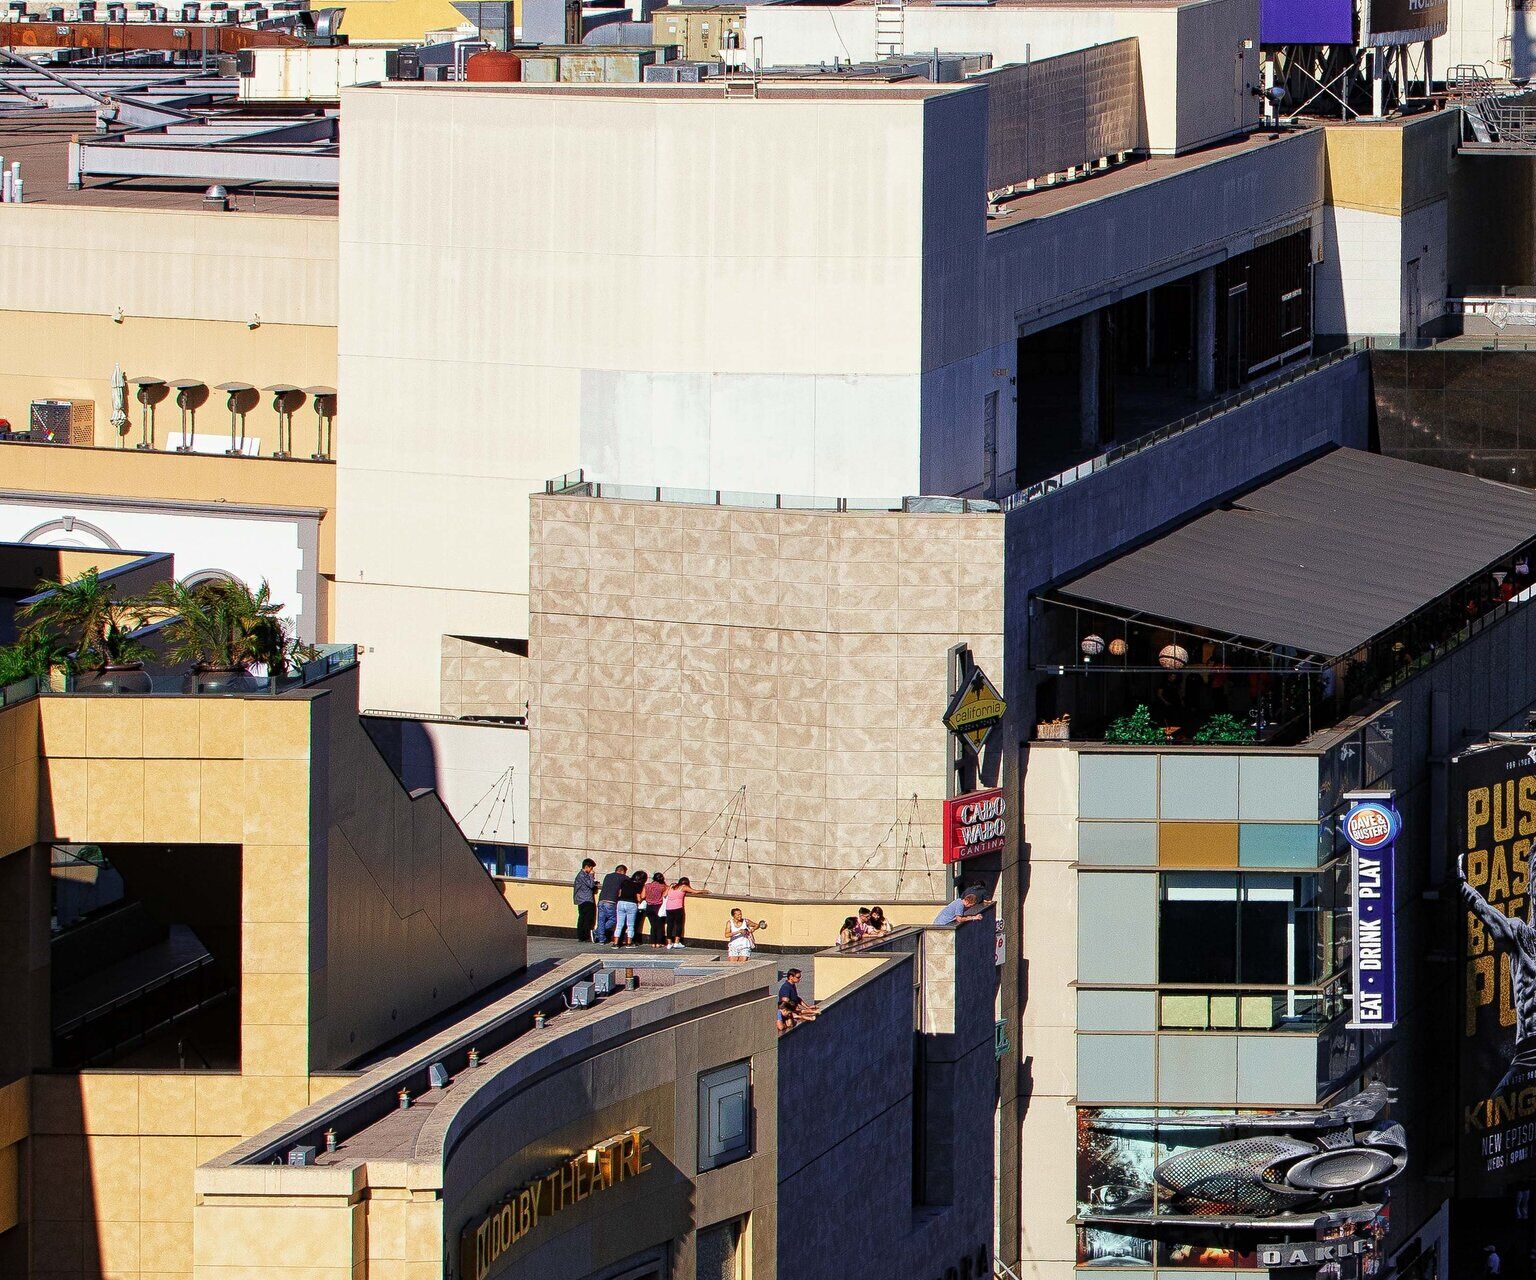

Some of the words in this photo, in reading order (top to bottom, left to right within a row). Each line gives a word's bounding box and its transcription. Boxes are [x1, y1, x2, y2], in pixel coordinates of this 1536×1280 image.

[955, 702, 1001, 723] california
[961, 797, 1006, 825] CABO
[1351, 815, 1376, 831] DAVE
[960, 818, 1006, 846] WABO
[960, 839, 1005, 857] CANTINA
[1359, 857, 1381, 898] PLAY
[1359, 919, 1382, 970] DRINK
[1360, 991, 1382, 1020] EAT
[1480, 1132, 1501, 1157] NEW
[490, 1180, 541, 1263] DOLBY
[543, 1126, 652, 1217] THEATRE
